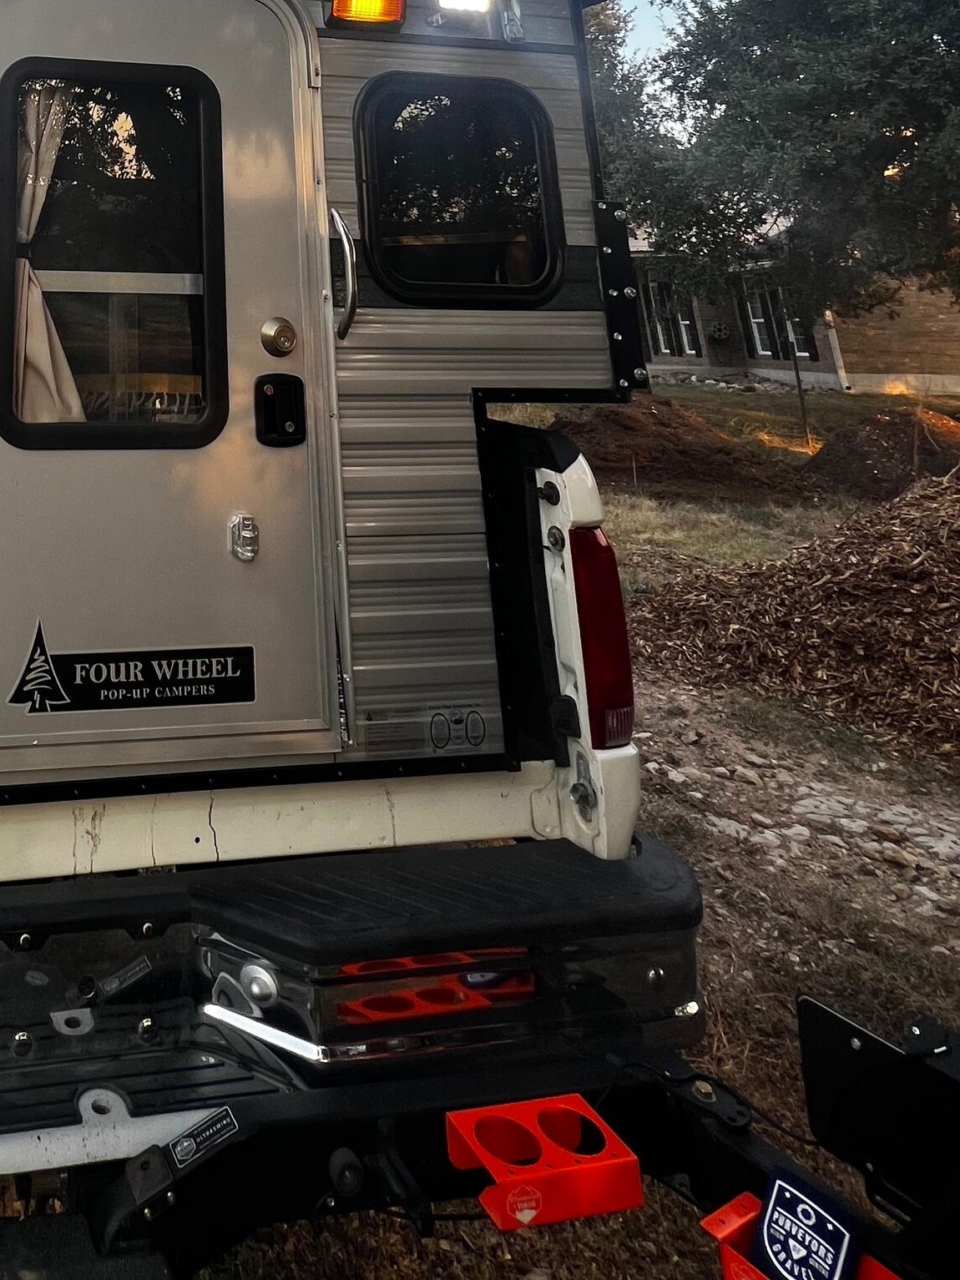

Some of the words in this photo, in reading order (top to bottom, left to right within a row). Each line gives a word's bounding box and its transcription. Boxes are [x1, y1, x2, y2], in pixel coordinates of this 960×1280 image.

[73, 661, 145, 685] FOUR
[150, 656, 241, 682] WHEEL
[100, 686, 151, 701] POP-UP
[154, 683, 216, 699] CAMPERS
[772, 1210, 835, 1266] PURVEYORS
